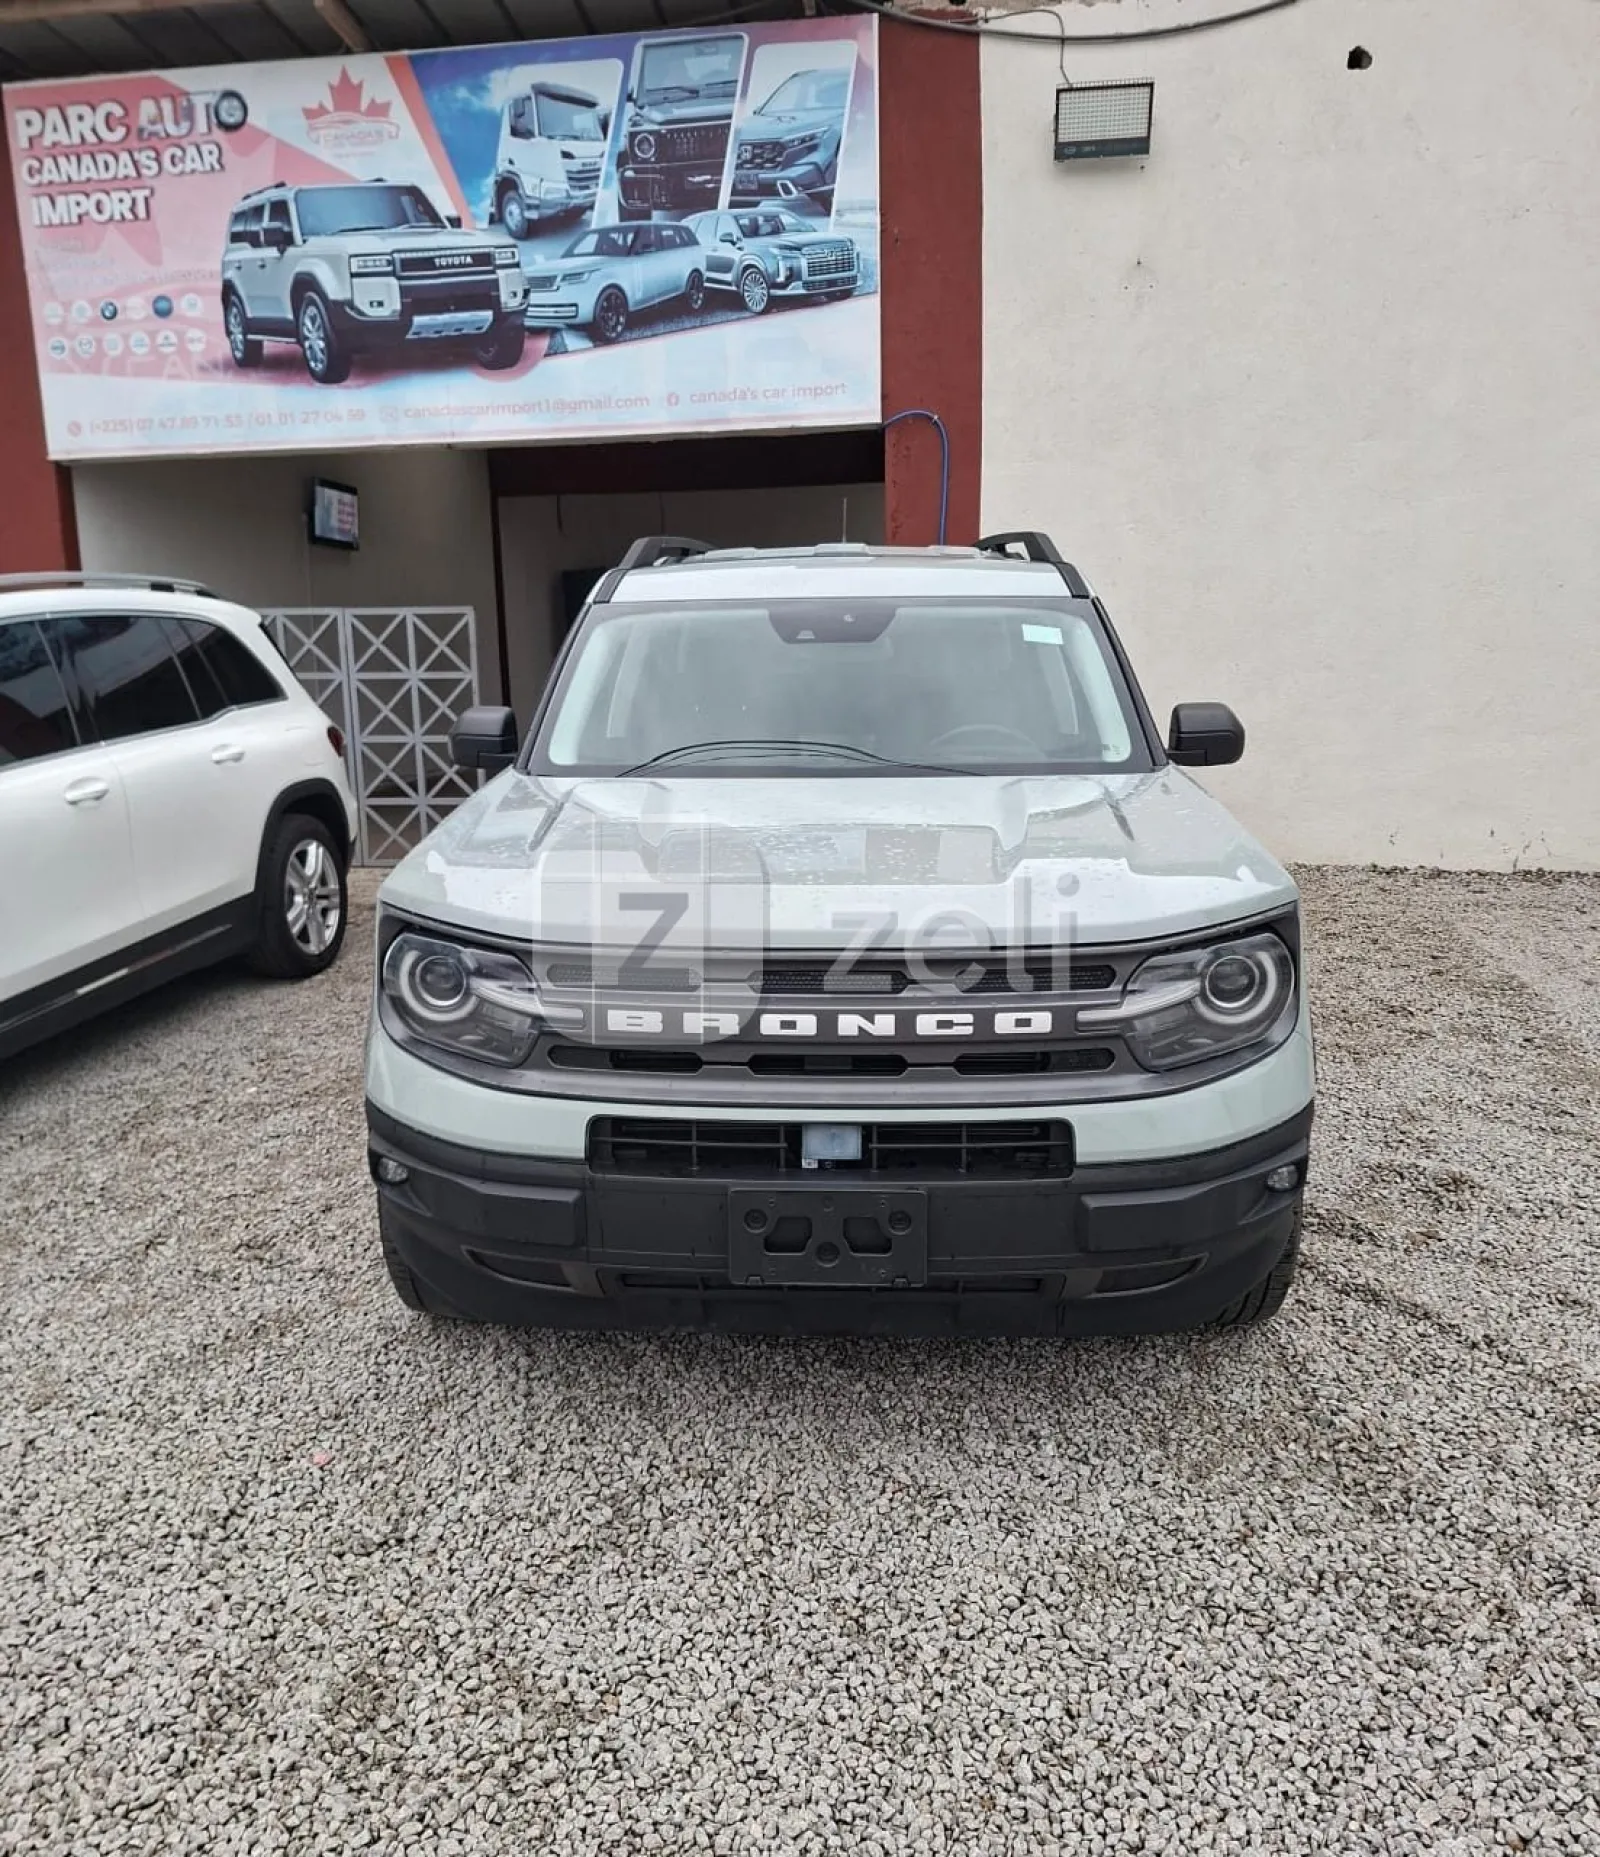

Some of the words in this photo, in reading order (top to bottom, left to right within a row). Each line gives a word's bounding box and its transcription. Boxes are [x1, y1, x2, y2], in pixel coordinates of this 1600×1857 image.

[15, 101, 128, 149] PARC
[22, 147, 161, 187] CANADA'S
[163, 142, 224, 176] CAR
[31, 188, 153, 228] IMPORT
[434, 255, 473, 267] TOYOTA
[689, 387, 759, 404] canada's
[762, 387, 789, 401] car
[791, 381, 848, 400] import
[606, 1008, 1054, 1036] BRONCO
